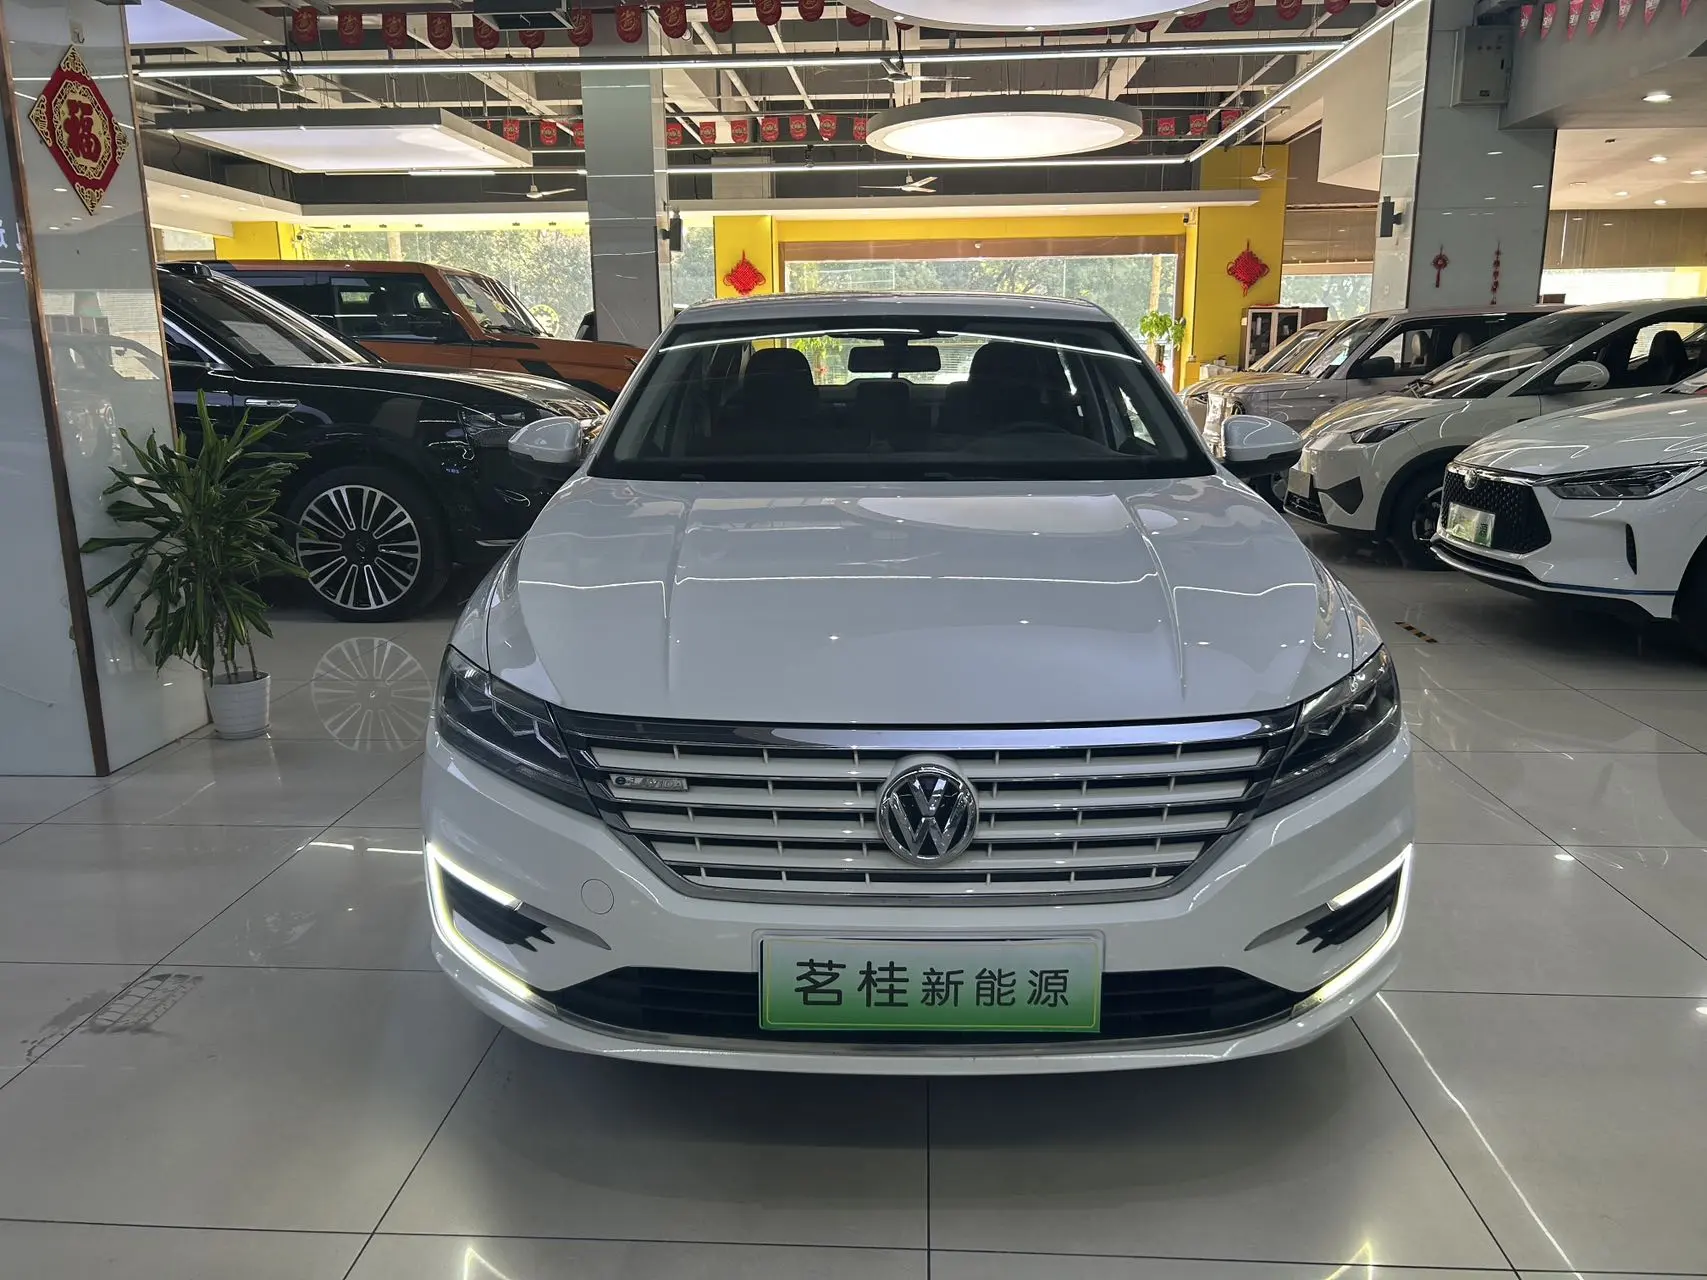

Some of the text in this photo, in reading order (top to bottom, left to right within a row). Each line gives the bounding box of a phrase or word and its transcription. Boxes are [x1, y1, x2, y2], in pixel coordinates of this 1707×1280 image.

[62, 98, 102, 163] 福
[794, 957, 1070, 1008] 茗桂新能源
